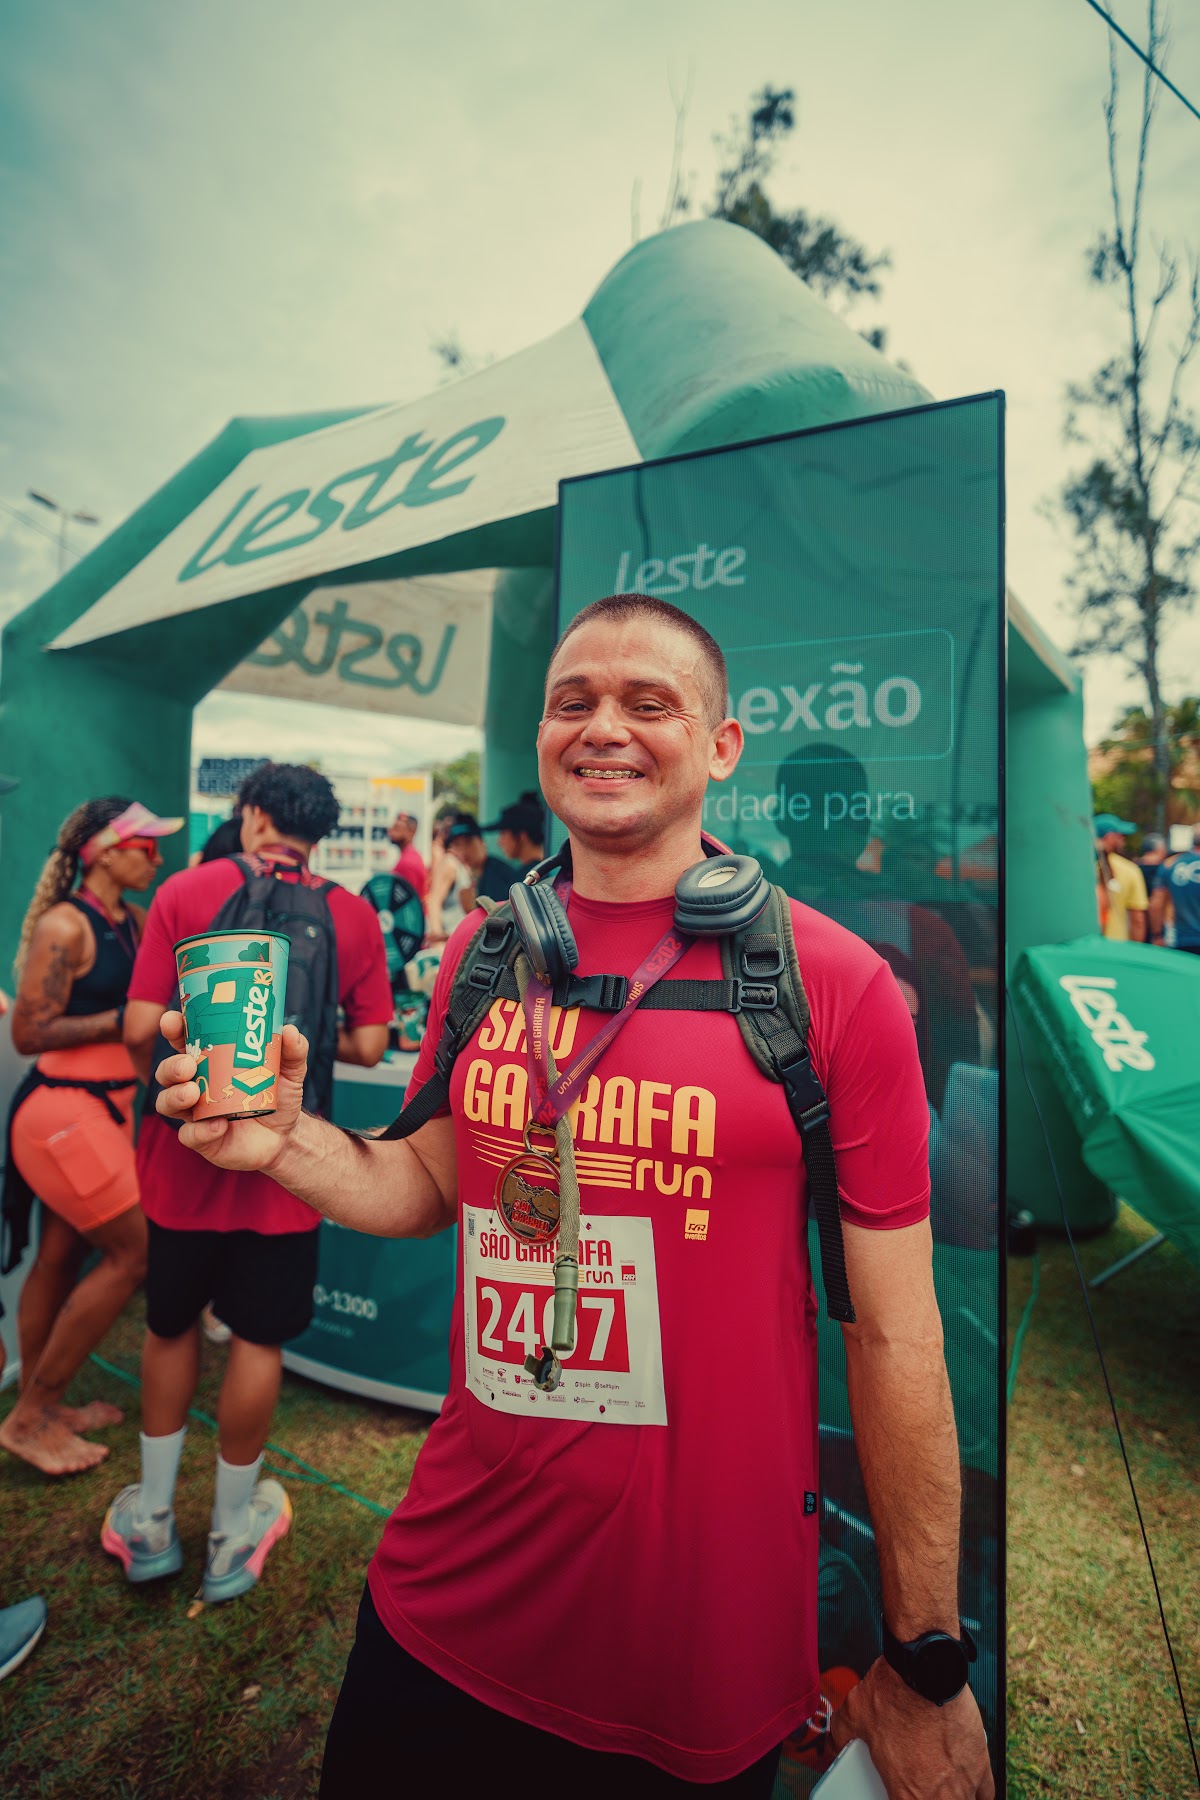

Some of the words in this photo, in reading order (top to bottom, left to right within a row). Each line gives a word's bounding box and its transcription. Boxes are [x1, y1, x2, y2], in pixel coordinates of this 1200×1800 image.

[728, 661, 922, 734] exão
[823, 790, 917, 830] para
[645, 936, 682, 975] 2025
[532, 997, 546, 1039] GARRAFA
[557, 1077, 573, 1095] run
[463, 1058, 717, 1158] GARAFA
[635, 1158, 713, 1199] run
[480, 1228, 510, 1261] SÃO
[515, 1239, 613, 1266] GARFA
[586, 1270, 614, 1284] run
